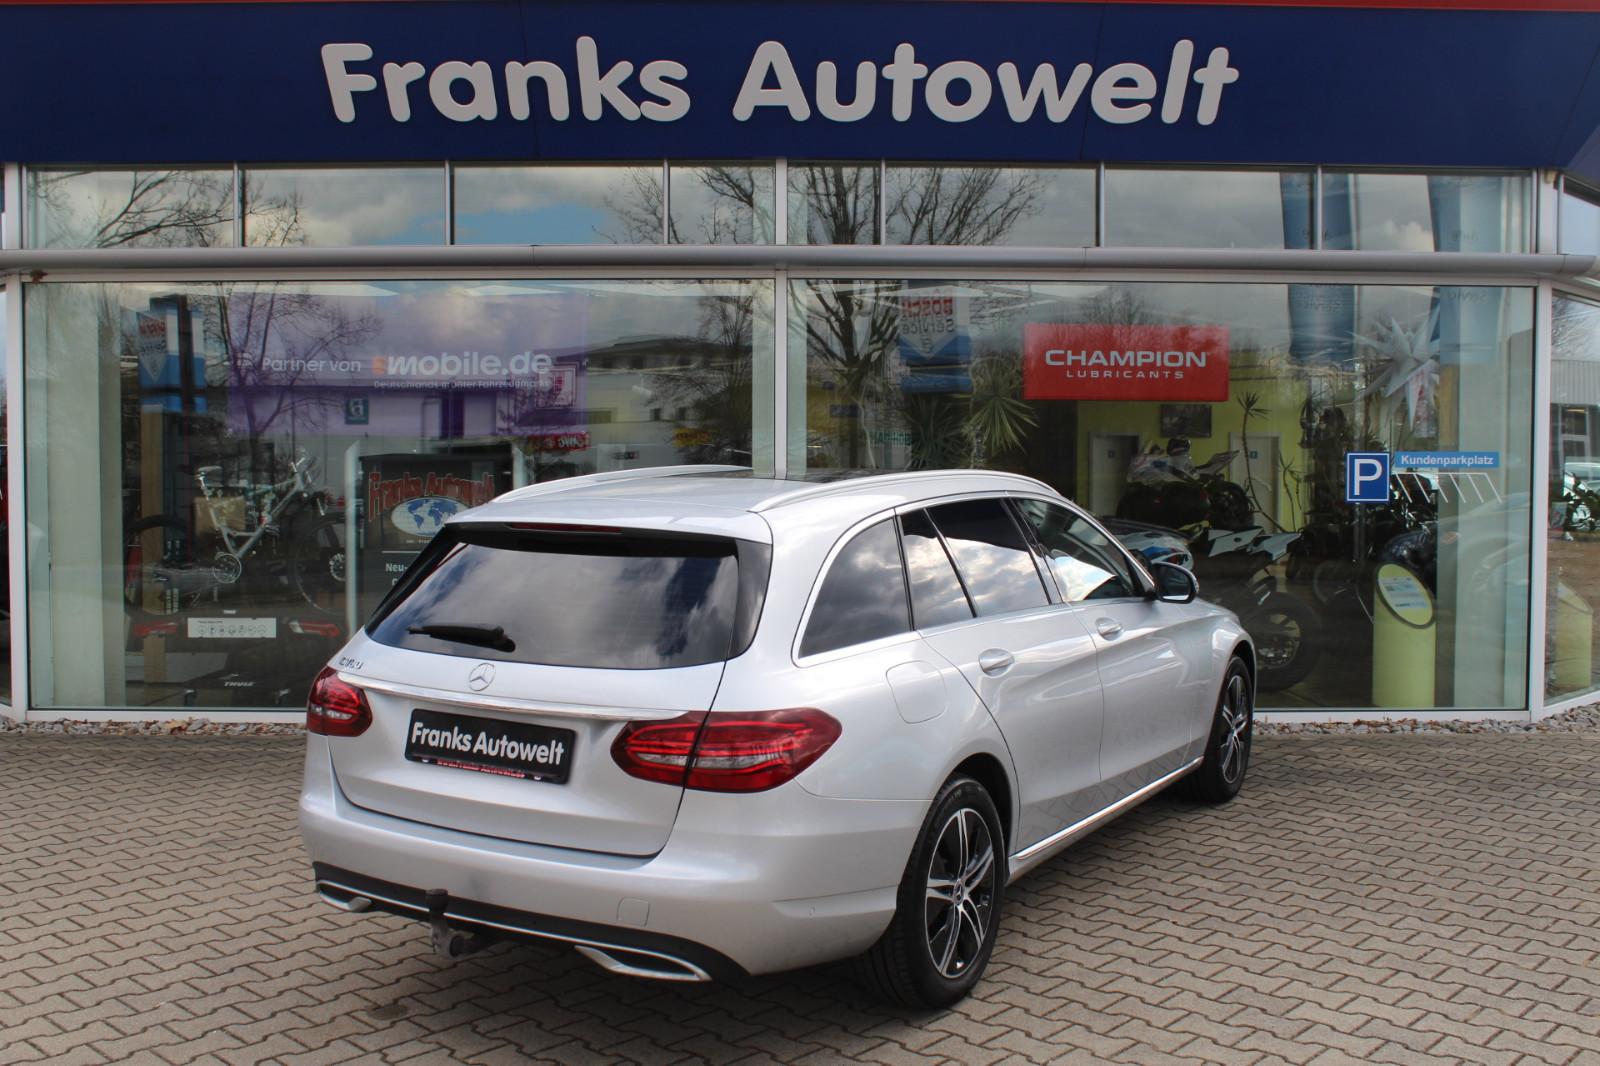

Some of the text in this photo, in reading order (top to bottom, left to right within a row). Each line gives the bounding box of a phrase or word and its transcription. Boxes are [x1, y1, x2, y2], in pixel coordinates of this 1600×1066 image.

[321, 36, 1240, 126] Franks Autowelt
[262, 351, 553, 376] Partner von mobile.de
[1045, 350, 1207, 368] CHAMPION
[1066, 370, 1185, 379] LUBRICANTS
[1401, 454, 1494, 468] Kundenparkplatz
[1353, 458, 1383, 496] P
[411, 721, 565, 766] Franks Autowelt
